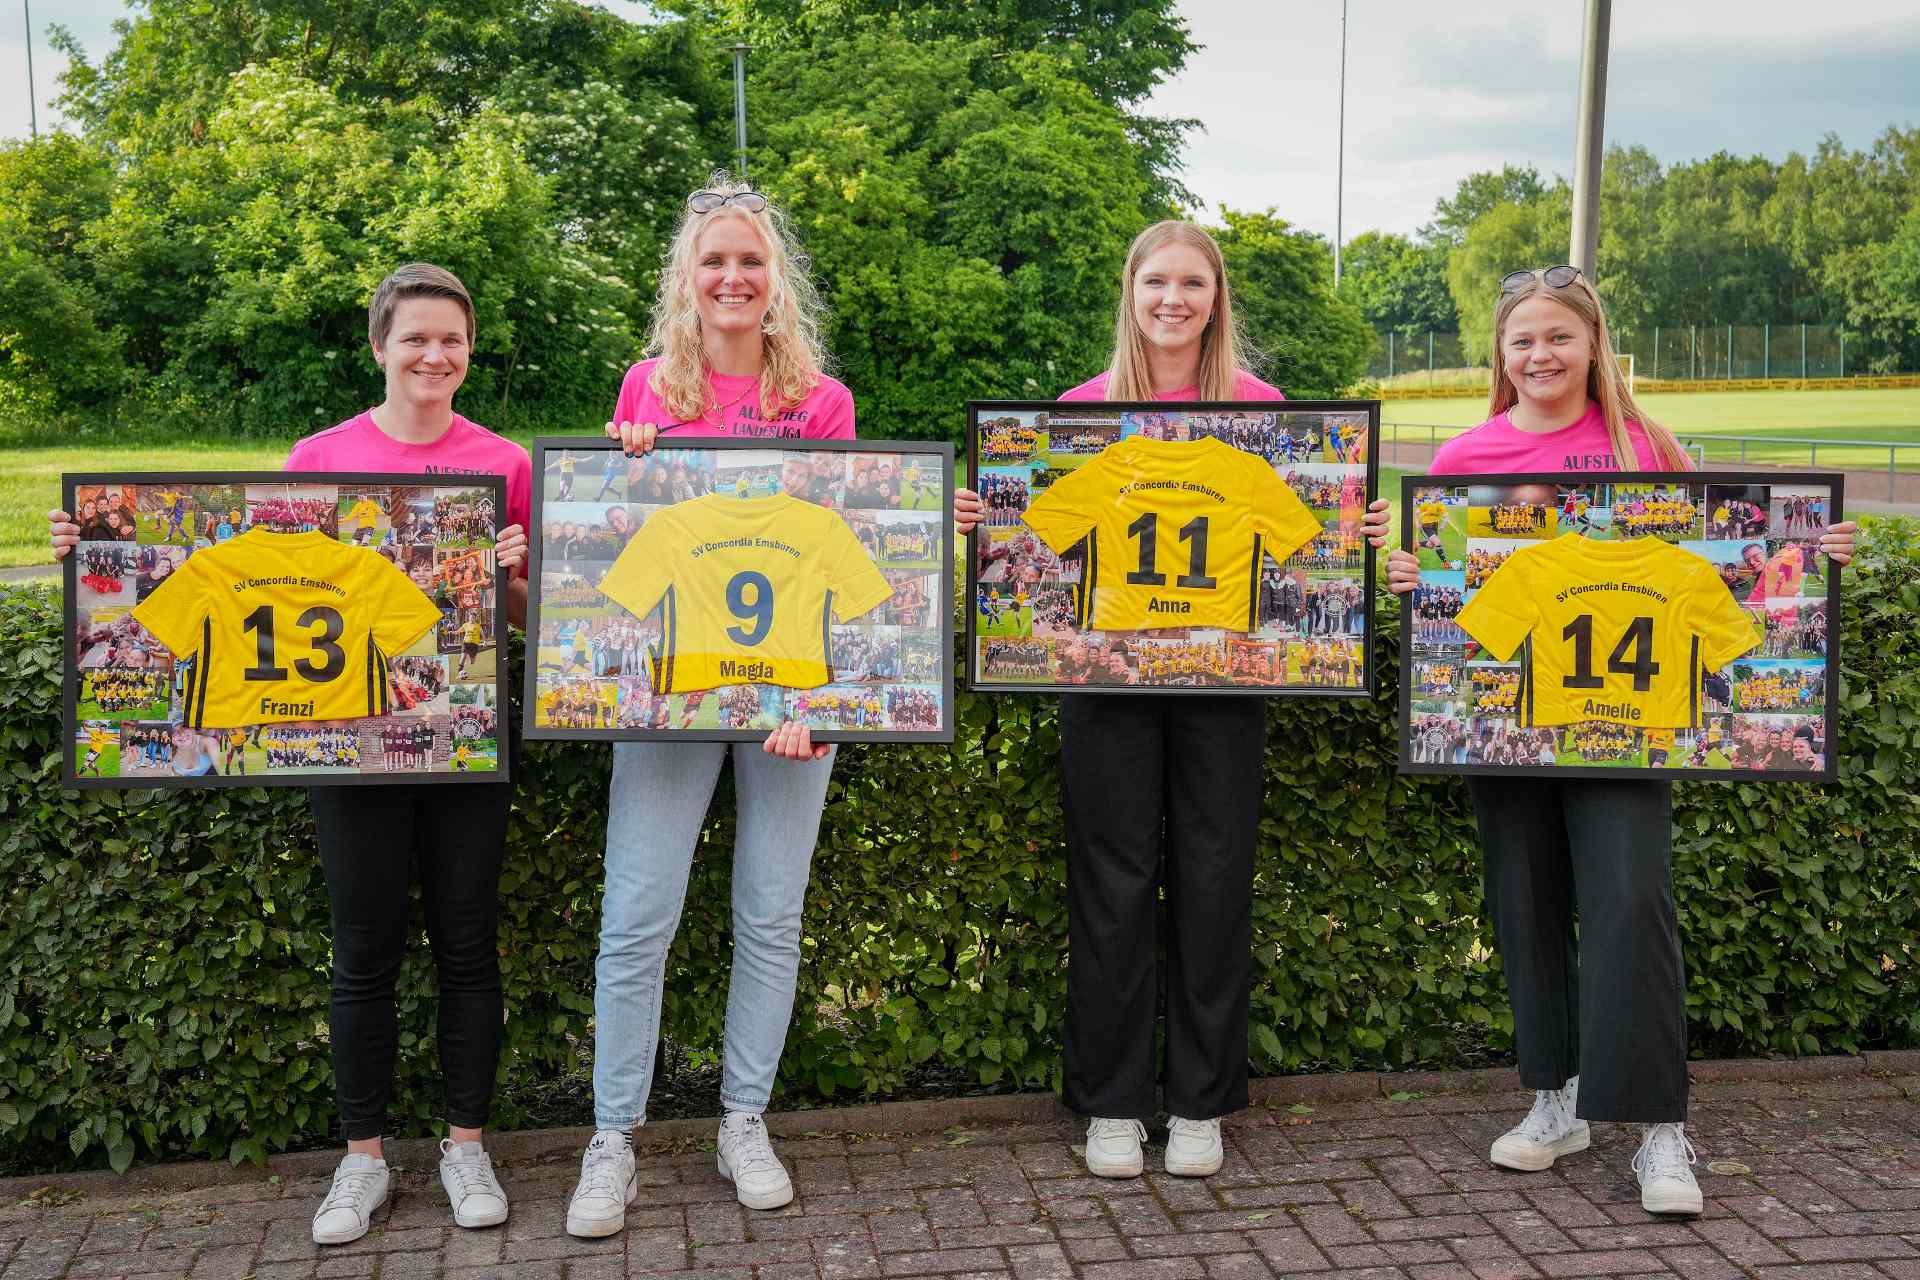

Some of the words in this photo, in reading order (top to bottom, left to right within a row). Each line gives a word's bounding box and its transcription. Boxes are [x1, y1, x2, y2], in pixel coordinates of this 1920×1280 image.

[691, 547, 704, 558] SV
[705, 537, 753, 552] Concordia
[1126, 512, 1217, 590] 11
[234, 581, 246, 593] SV
[248, 575, 298, 588] Concordia
[1556, 590, 1569, 603] SV
[1570, 581, 1619, 596] Concordia
[725, 570, 775, 647] 9
[1148, 596, 1191, 614] Anna
[243, 605, 346, 683] 13
[1562, 614, 1660, 692] 14
[719, 660, 774, 681] Magda
[260, 697, 314, 717] Franzi
[1583, 698, 1641, 720] Amelie
